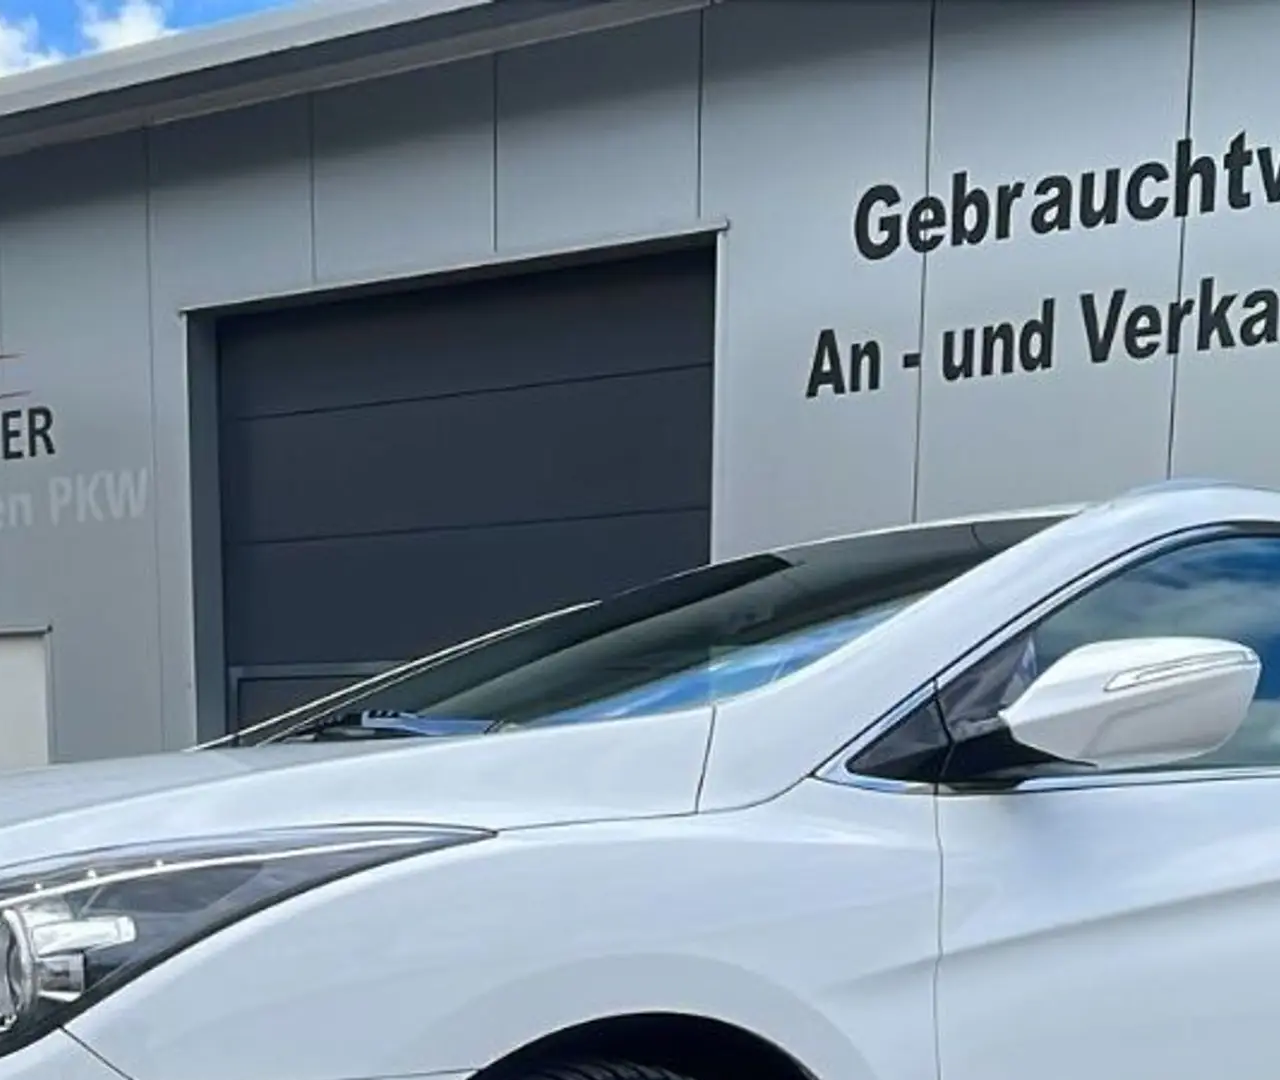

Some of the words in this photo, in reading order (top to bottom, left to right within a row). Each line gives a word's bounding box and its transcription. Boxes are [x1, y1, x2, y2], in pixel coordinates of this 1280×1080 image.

[805, 329, 881, 399] An
[942, 298, 1055, 382] und
[48, 466, 149, 528] PKW
